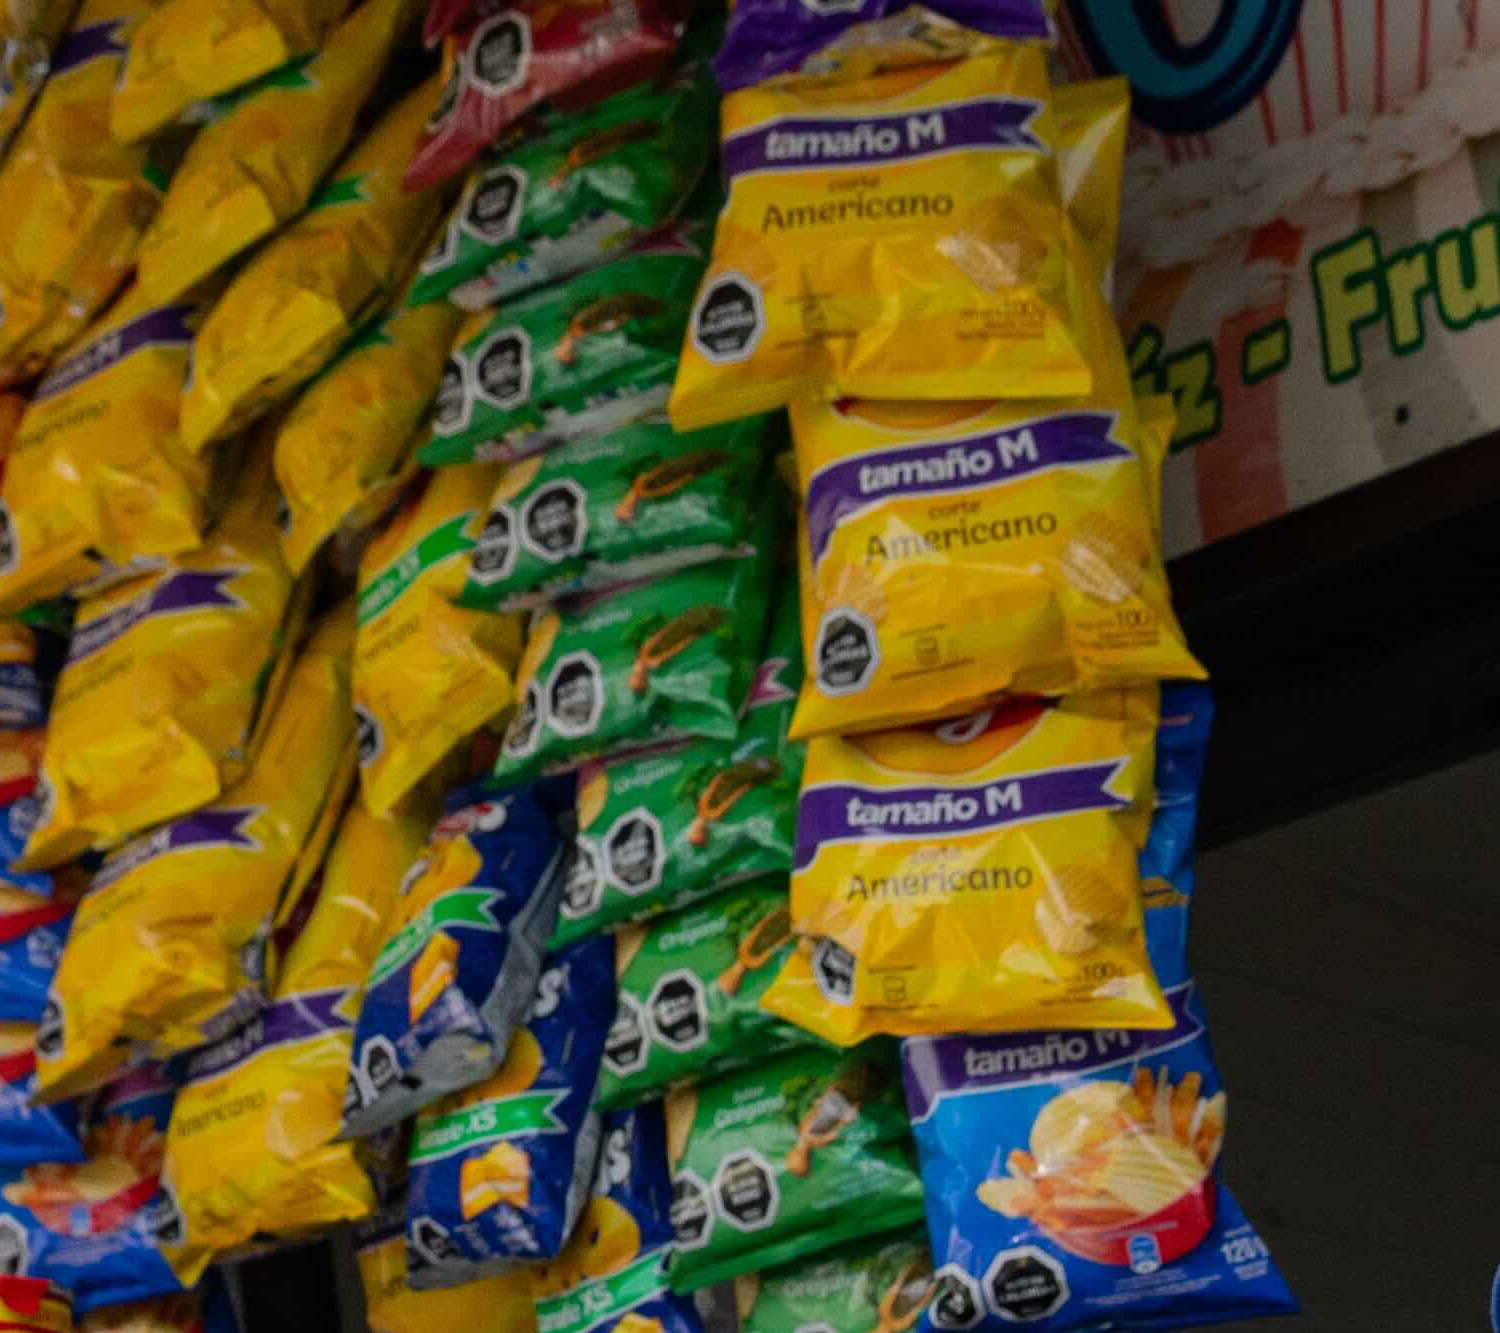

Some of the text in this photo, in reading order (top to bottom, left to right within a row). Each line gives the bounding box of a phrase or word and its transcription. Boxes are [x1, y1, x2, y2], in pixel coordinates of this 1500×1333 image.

[765, 113, 946, 163] tamaño M
[760, 188, 955, 235] Americano
[858, 433, 1040, 495] tamaño M
[863, 506, 1059, 567] Americano
[845, 783, 1025, 831] tamaño M
[845, 859, 1035, 904] Americano
[962, 1036, 1090, 1081] tamaño
